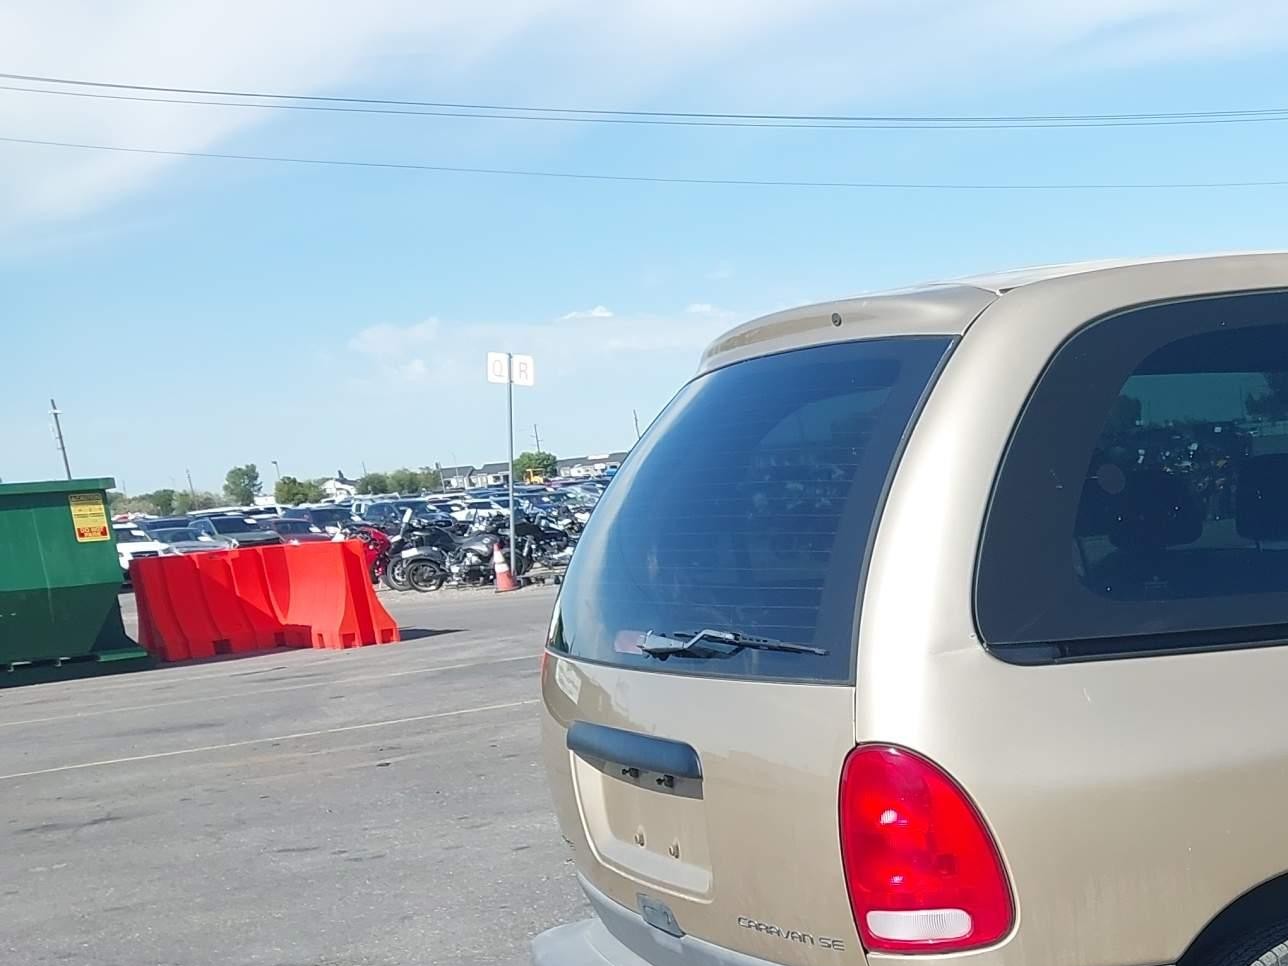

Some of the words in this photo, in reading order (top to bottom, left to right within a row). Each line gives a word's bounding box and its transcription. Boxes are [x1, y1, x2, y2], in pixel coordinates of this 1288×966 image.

[519, 361, 529, 380] R
[738, 916, 815, 945] CARAVAN
[819, 937, 845, 951] SE
